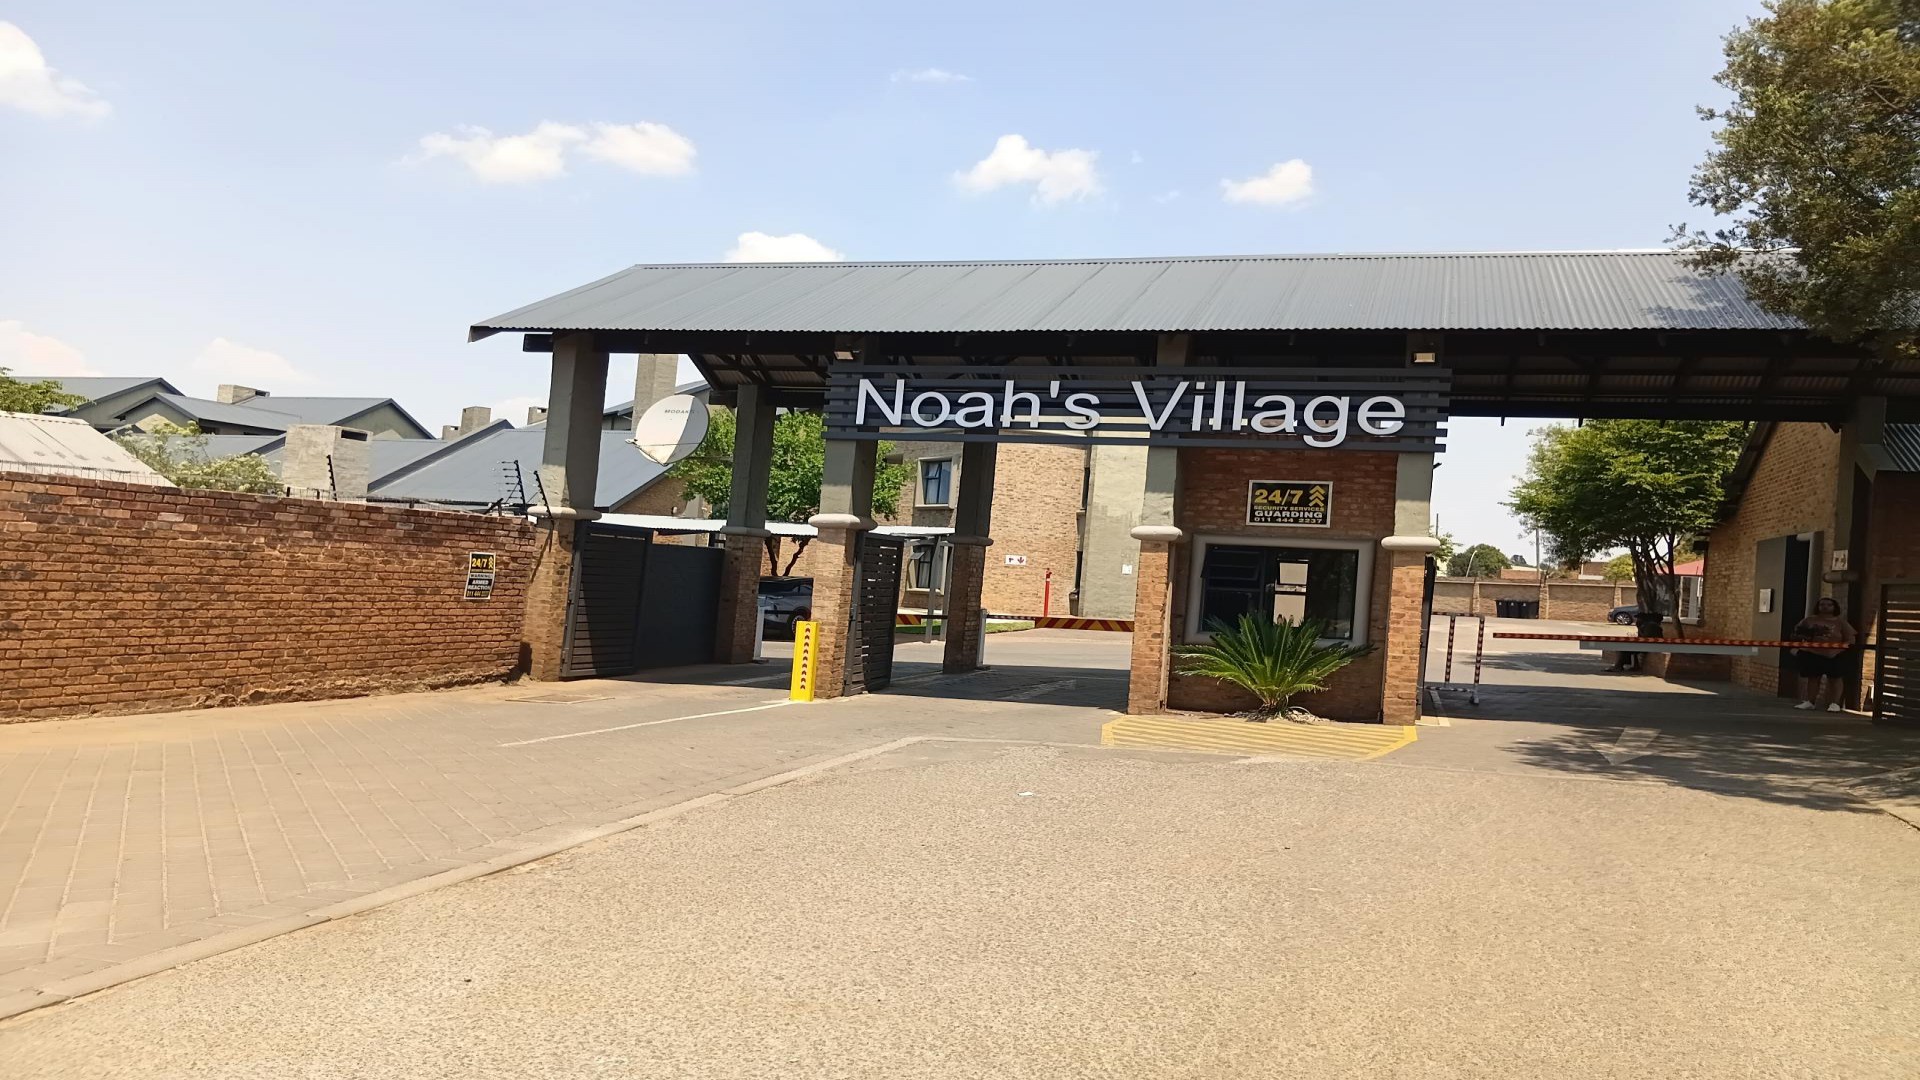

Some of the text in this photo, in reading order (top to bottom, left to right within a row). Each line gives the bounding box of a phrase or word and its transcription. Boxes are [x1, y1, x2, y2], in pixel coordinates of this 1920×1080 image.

[855, 378, 1406, 448] Noah's Village
[1254, 489, 1304, 505] 24/7
[472, 558, 487, 568] 24/7
